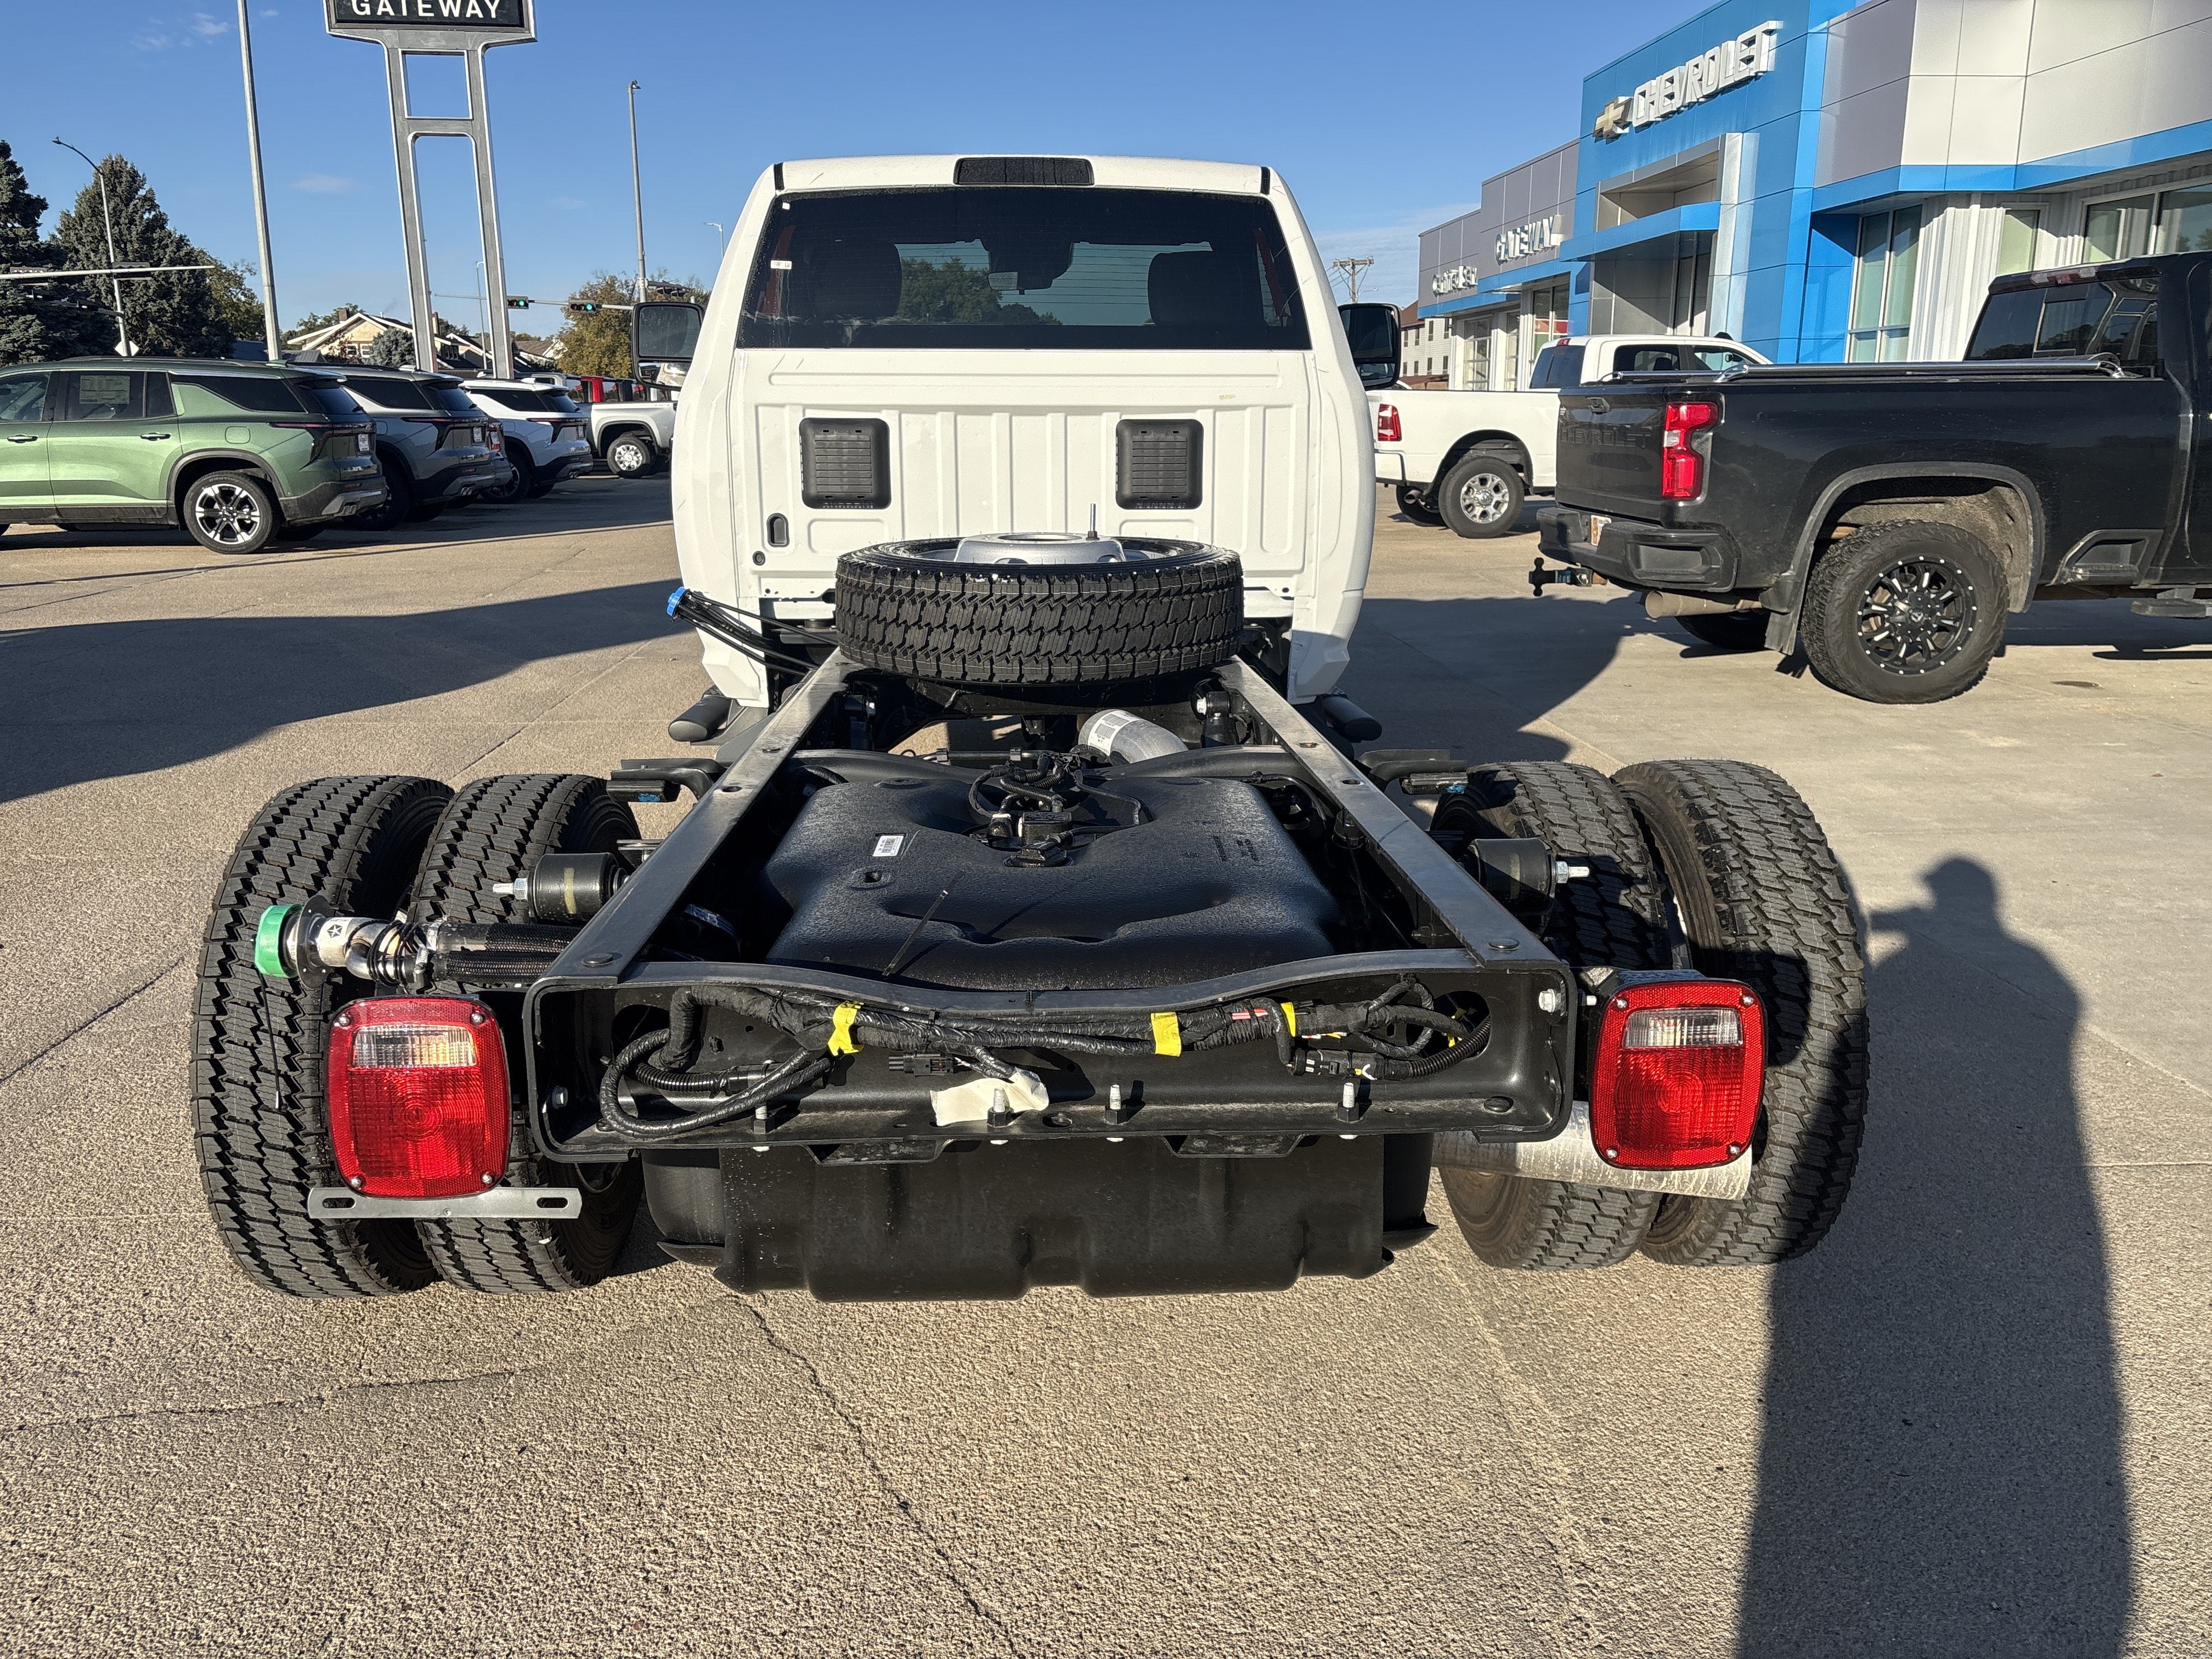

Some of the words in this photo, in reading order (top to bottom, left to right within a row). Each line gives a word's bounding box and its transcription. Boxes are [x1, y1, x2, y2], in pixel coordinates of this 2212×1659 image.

[1632, 20, 1782, 128] CHEVROLET
[1495, 215, 1563, 263] GATEWAY
[1560, 427, 1651, 448] CHEVROLET
